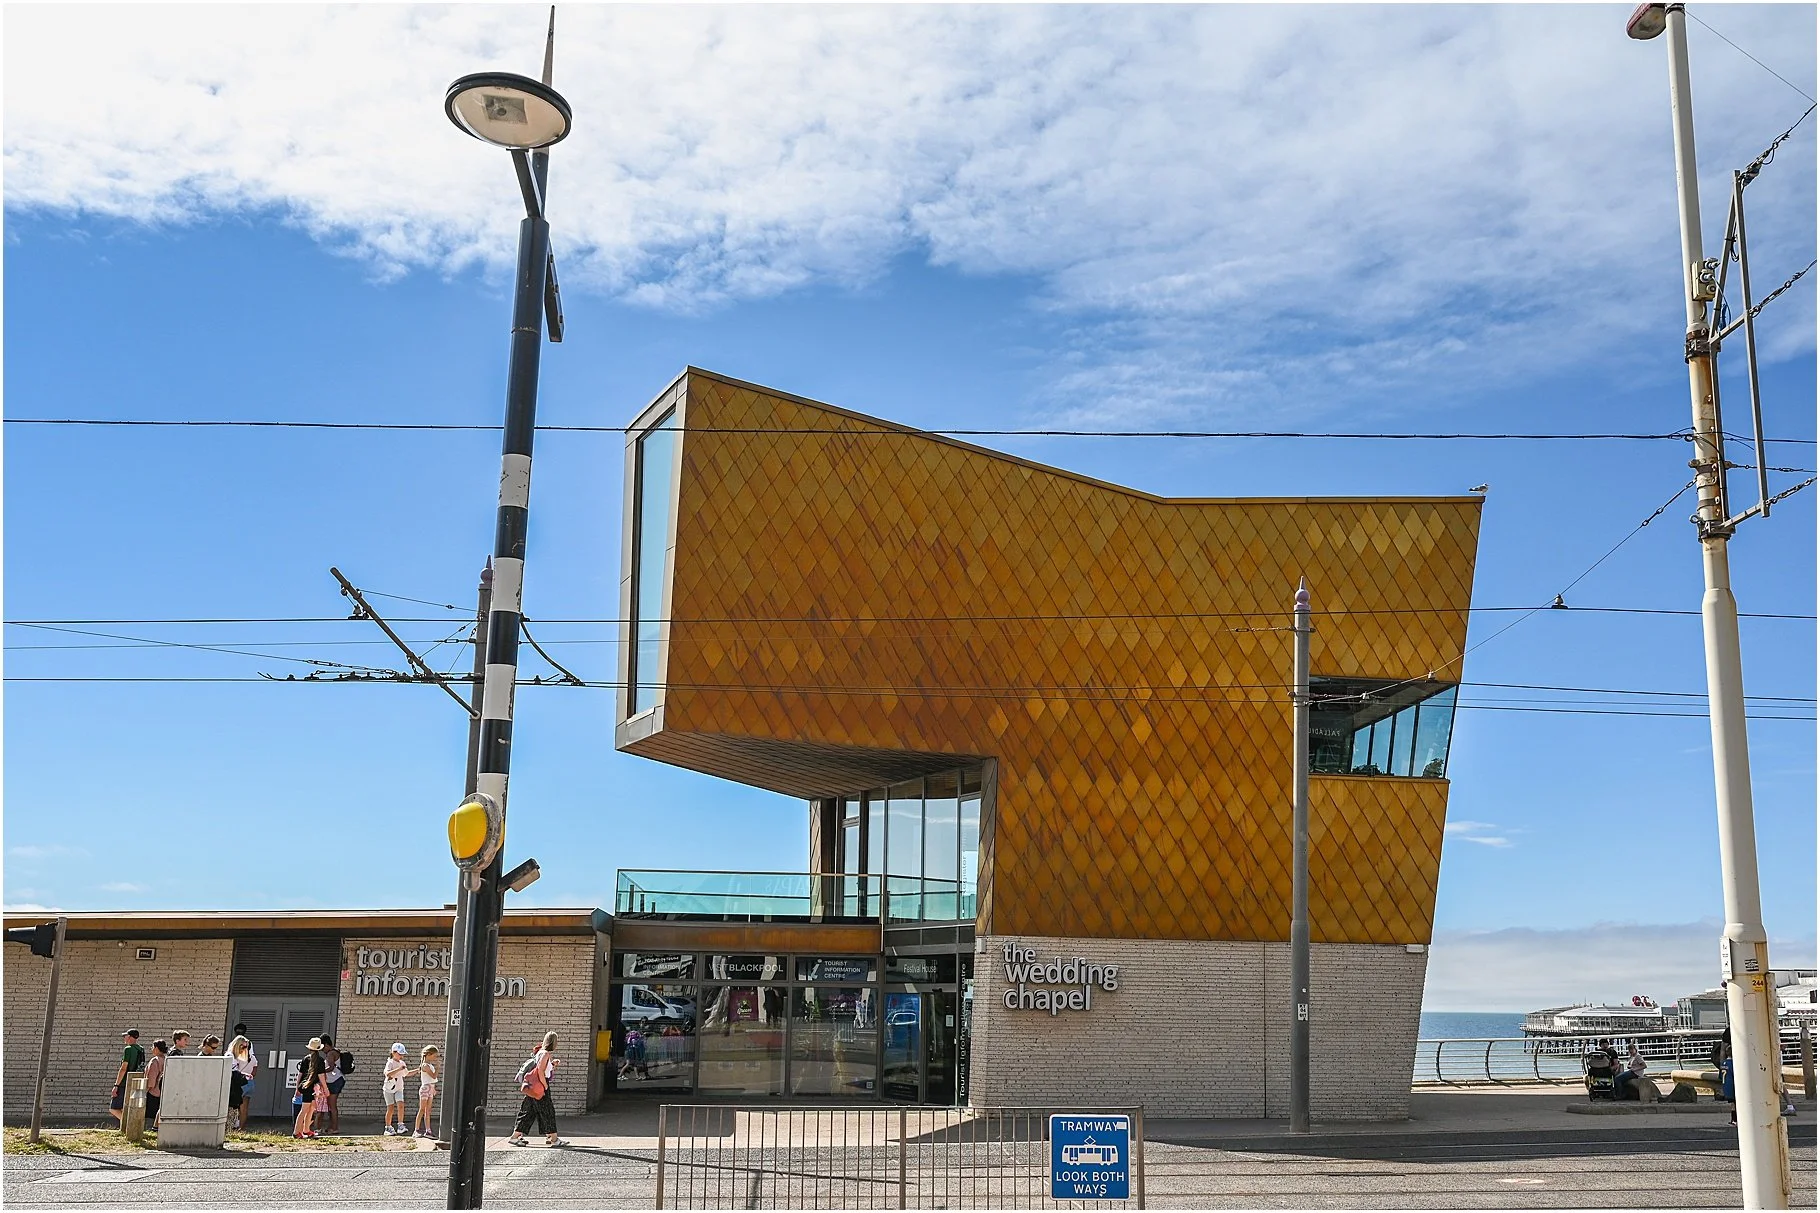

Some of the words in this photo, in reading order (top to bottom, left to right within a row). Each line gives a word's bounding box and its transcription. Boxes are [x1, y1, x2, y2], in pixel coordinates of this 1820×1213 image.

[356, 944, 452, 970] tourist
[1003, 942, 1036, 963] the
[922, 964, 937, 974] House
[1004, 957, 1119, 991] wedding
[355, 968, 527, 997] informon
[1003, 984, 1092, 1016] chapel
[1060, 1121, 1118, 1131] TRAMWAY
[1056, 1171, 1088, 1182] LOOK
[1092, 1171, 1124, 1182] BOTH
[1073, 1184, 1107, 1194] WAYS
